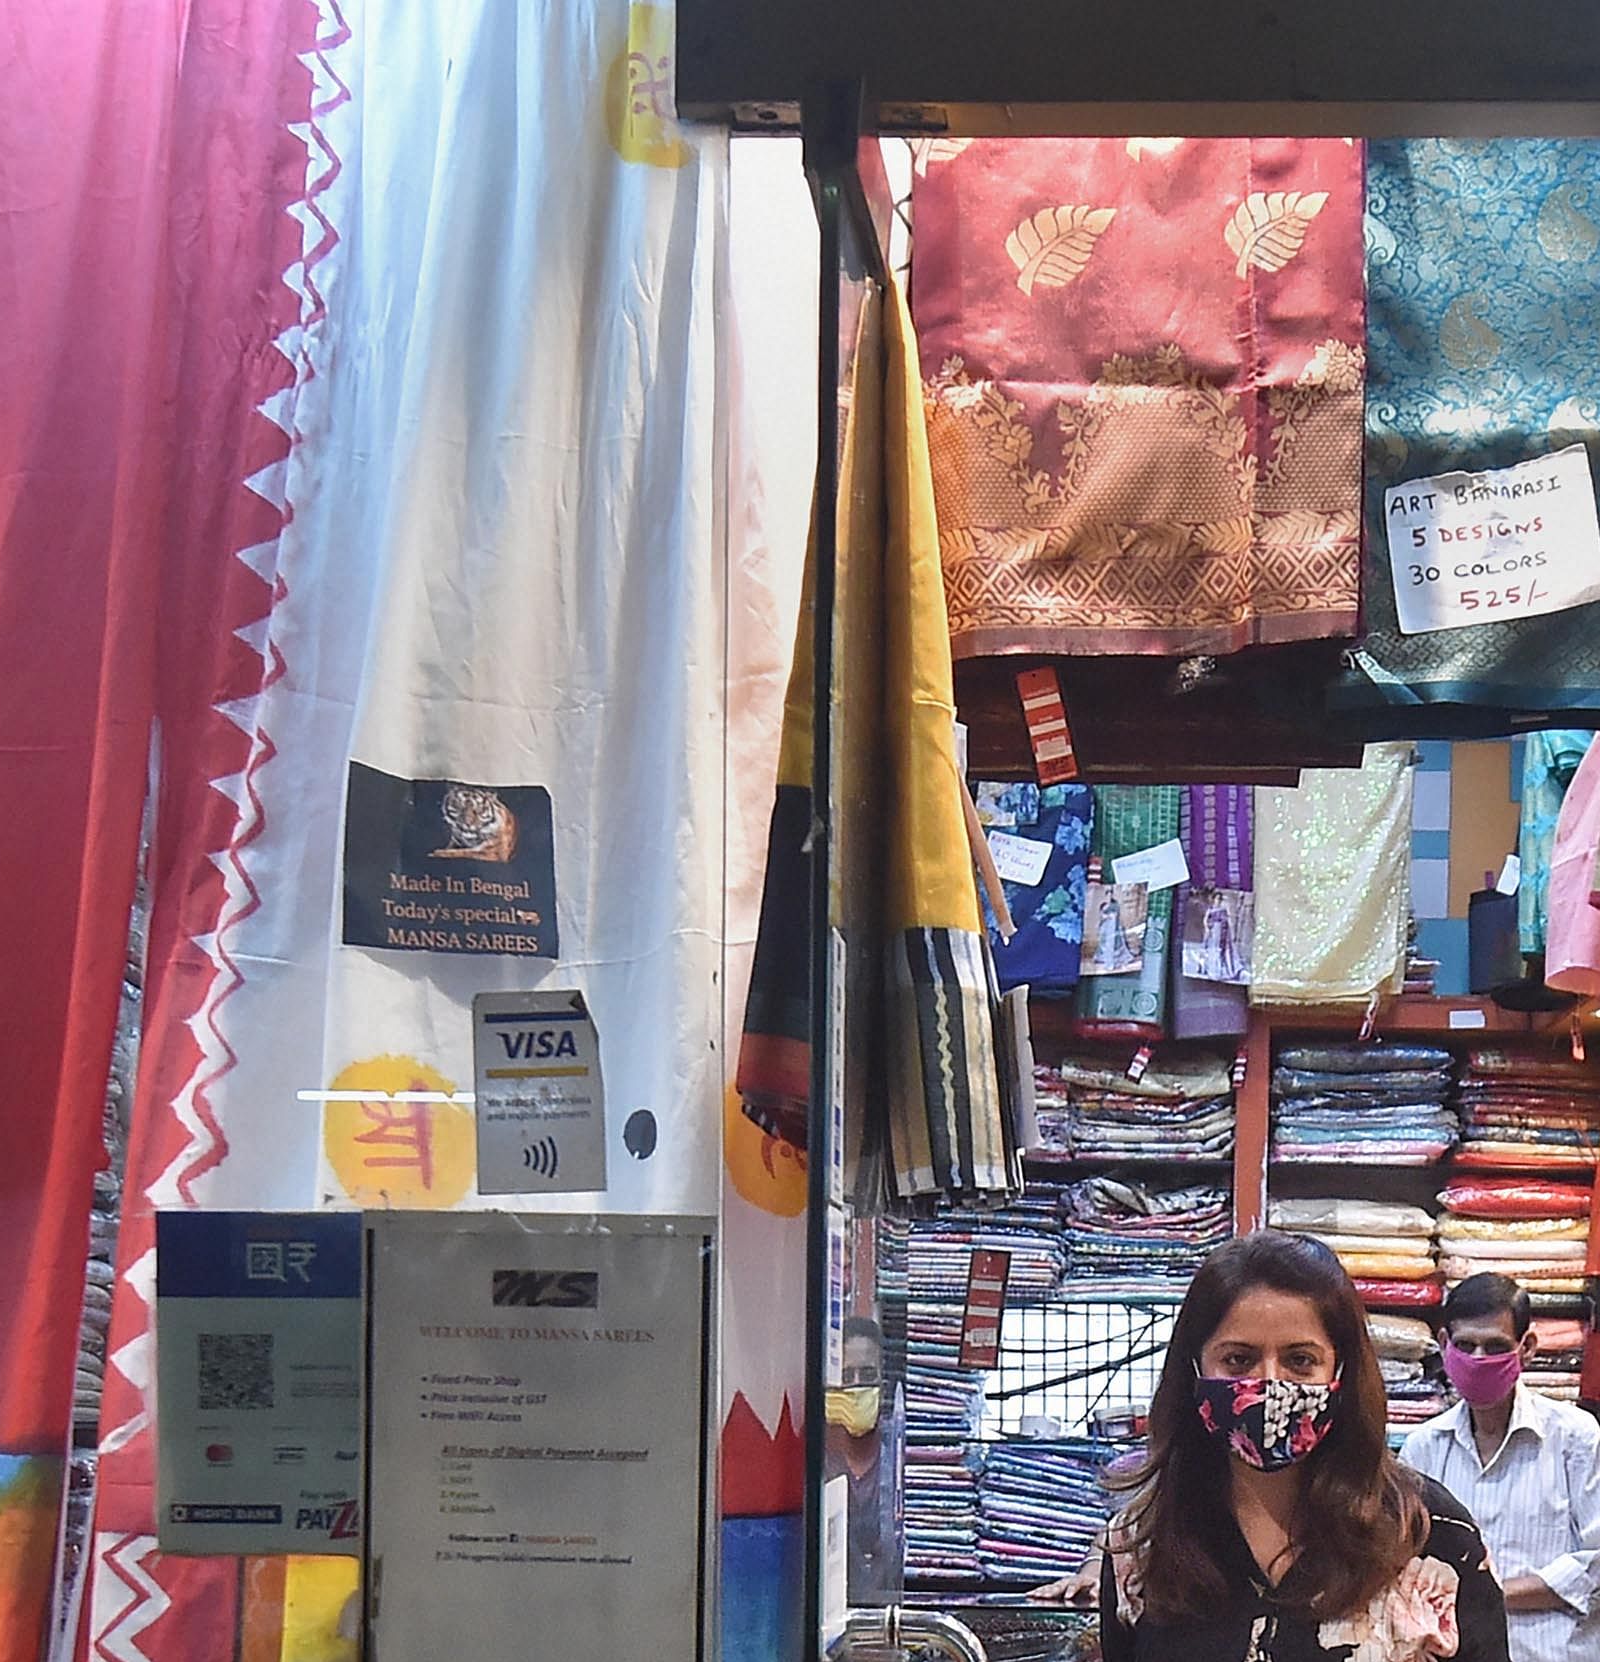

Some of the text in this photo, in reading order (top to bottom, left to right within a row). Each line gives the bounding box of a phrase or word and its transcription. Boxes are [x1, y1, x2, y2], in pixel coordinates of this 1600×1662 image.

[1390, 475, 1562, 516] ART BANARASI
[1412, 516, 1544, 547] 5 DESIGNS
[1408, 551, 1547, 586] 30 COLORS
[1460, 579, 1549, 610] 525/-
[389, 872, 530, 901] Made In Bengal
[382, 899, 517, 926] Today's special
[388, 928, 538, 952] MANSA SAREES
[496, 1030, 577, 1059] VISA
[419, 1325, 501, 1341] WELCOME
[509, 1327, 529, 1341] TO
